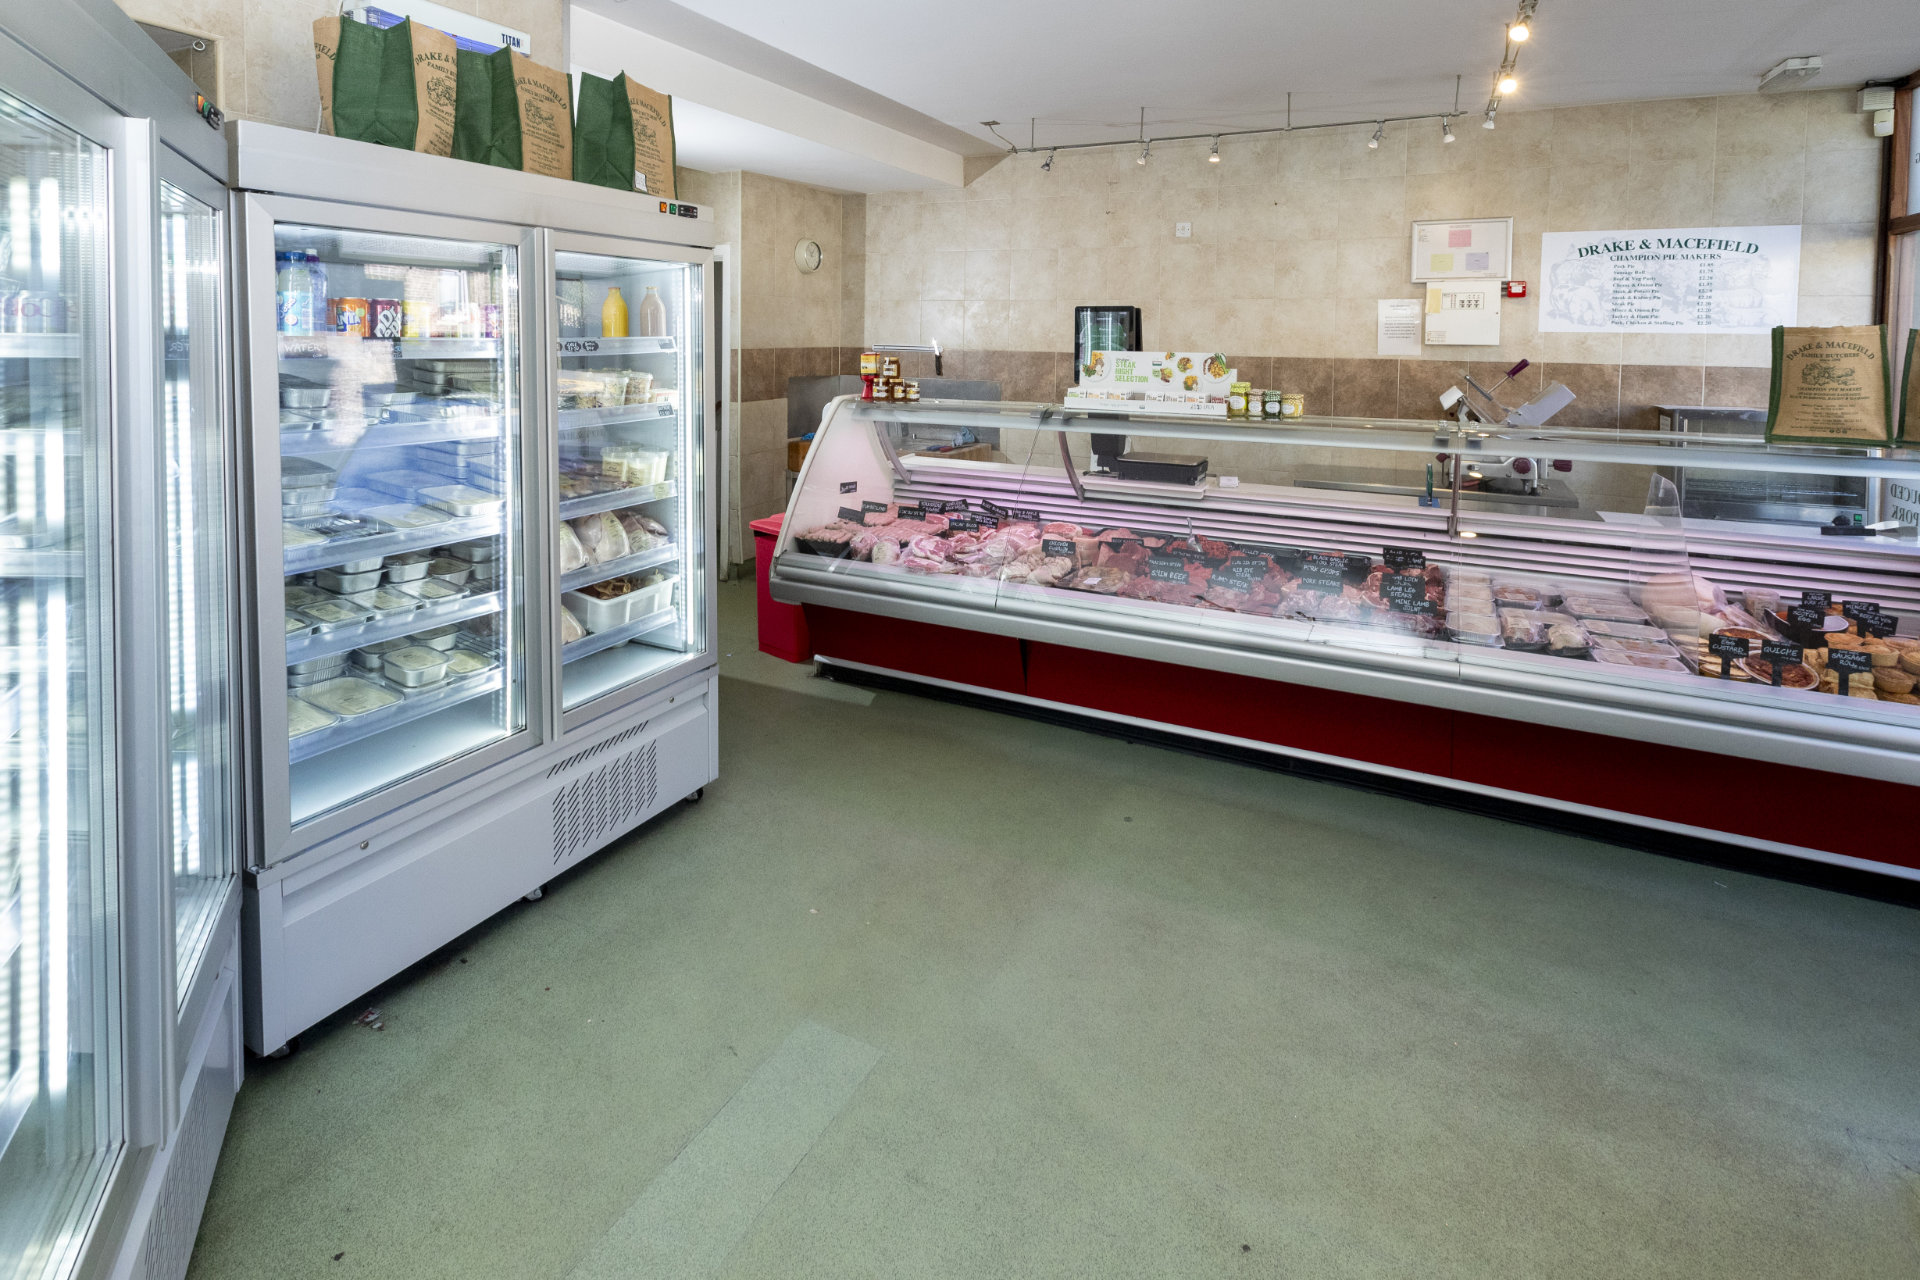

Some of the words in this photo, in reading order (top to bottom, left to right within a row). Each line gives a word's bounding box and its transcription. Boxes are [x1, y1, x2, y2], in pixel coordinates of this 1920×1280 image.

[501, 33, 521, 48] TITAN
[415, 52, 442, 65] DRAKE
[444, 54, 450, 63] &
[532, 79, 567, 110] MACEFIELD
[1577, 239, 1635, 258] DRAKE
[1638, 239, 1652, 250] &
[1656, 237, 1760, 255] MACEFIELD
[1609, 254, 1660, 262] CHAMPION
[1680, 253, 1722, 261] MAKERS
[284, 342, 321, 353] WATER
[1786, 344, 1814, 361] DRAKE
[1815, 341, 1823, 349] &
[1825, 341, 1875, 360] MACEFIELD
[1114, 375, 1149, 383] SELECTION
[1151, 569, 1168, 578] SHIN
[1169, 571, 1187, 581] BEEF
[1303, 564, 1319, 572] PORK
[1319, 567, 1340, 576] CHOPS
[1228, 578, 1249, 589] STEAK
[1390, 591, 1413, 599] STEAKS
[1791, 610, 1818, 620] SCOTCH
[1712, 643, 1744, 653] CUSTARD
[1763, 646, 1798, 657] QUICHE
[1831, 652, 1867, 662] SAUSAGE
